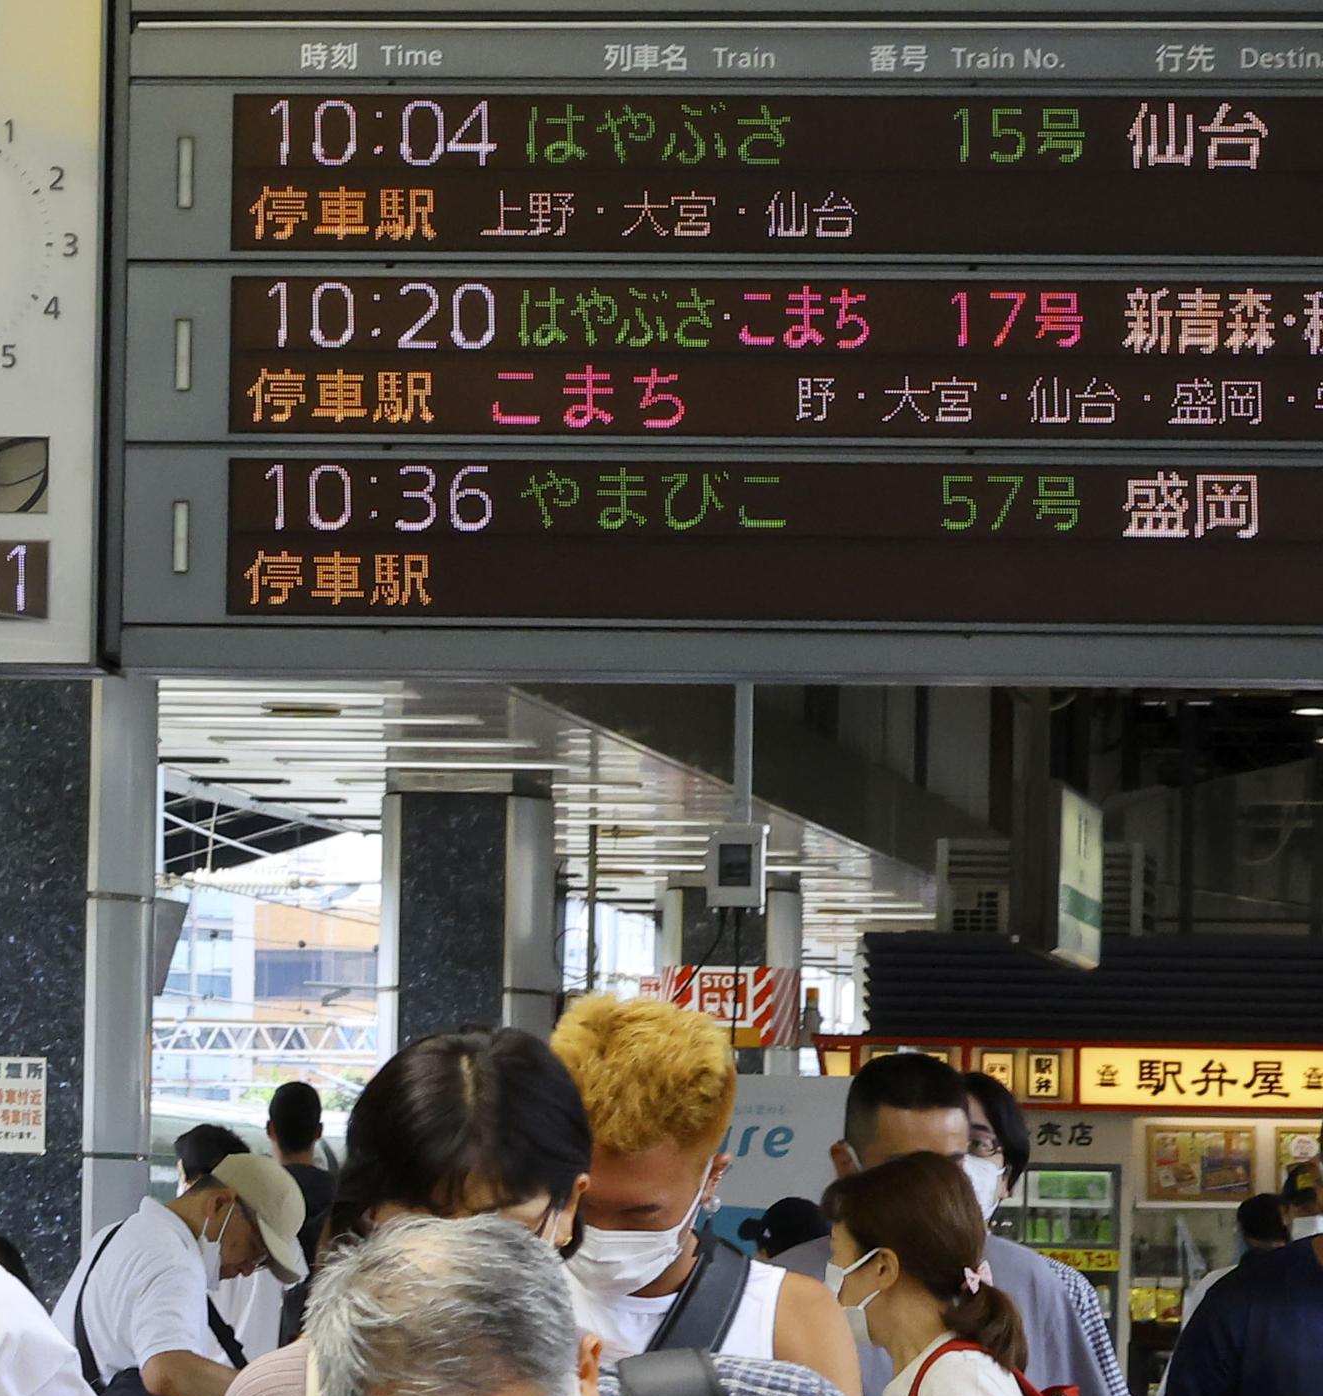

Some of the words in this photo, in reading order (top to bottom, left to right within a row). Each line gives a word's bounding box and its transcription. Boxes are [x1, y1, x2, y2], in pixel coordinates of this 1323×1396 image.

[300, 42, 358, 70] 時刻
[380, 44, 443, 66] Time
[604, 43, 687, 72] 列車名
[712, 46, 776, 69] Train
[869, 44, 929, 73] 番号
[950, 46, 1015, 69] Train
[1023, 47, 1065, 69] No.
[1155, 44, 1215, 73] 行先
[1240, 46, 1323, 69] Destin
[4, 119, 14, 143] 1
[270, 99, 498, 166] 10:04
[526, 101, 791, 165] はやぶさ
[953, 108, 1086, 163] 15号
[1126, 102, 1269, 170] 仙台
[49, 166, 65, 191] 2
[249, 185, 437, 241] 停車駅
[62, 232, 79, 258] 3
[36, 296, 61, 320] 4
[268, 281, 496, 350] 10:20
[951, 291, 1084, 348] 17号
[1, 344, 17, 369] 5
[246, 367, 435, 424] 停車駅
[492, 364, 686, 429] こまち
[265, 464, 492, 532] 10:36
[520, 467, 787, 531] やまびこ
[940, 475, 1081, 531] 57号
[1122, 471, 1259, 539] 盛岡
[243, 550, 432, 606] 停車駅
[701, 974, 745, 989] STOP
[1034, 1057, 1054, 1094] 駅弁
[1136, 1059, 1291, 1099] 駅弁屋
[1028, 1121, 1094, 1147] 売店
